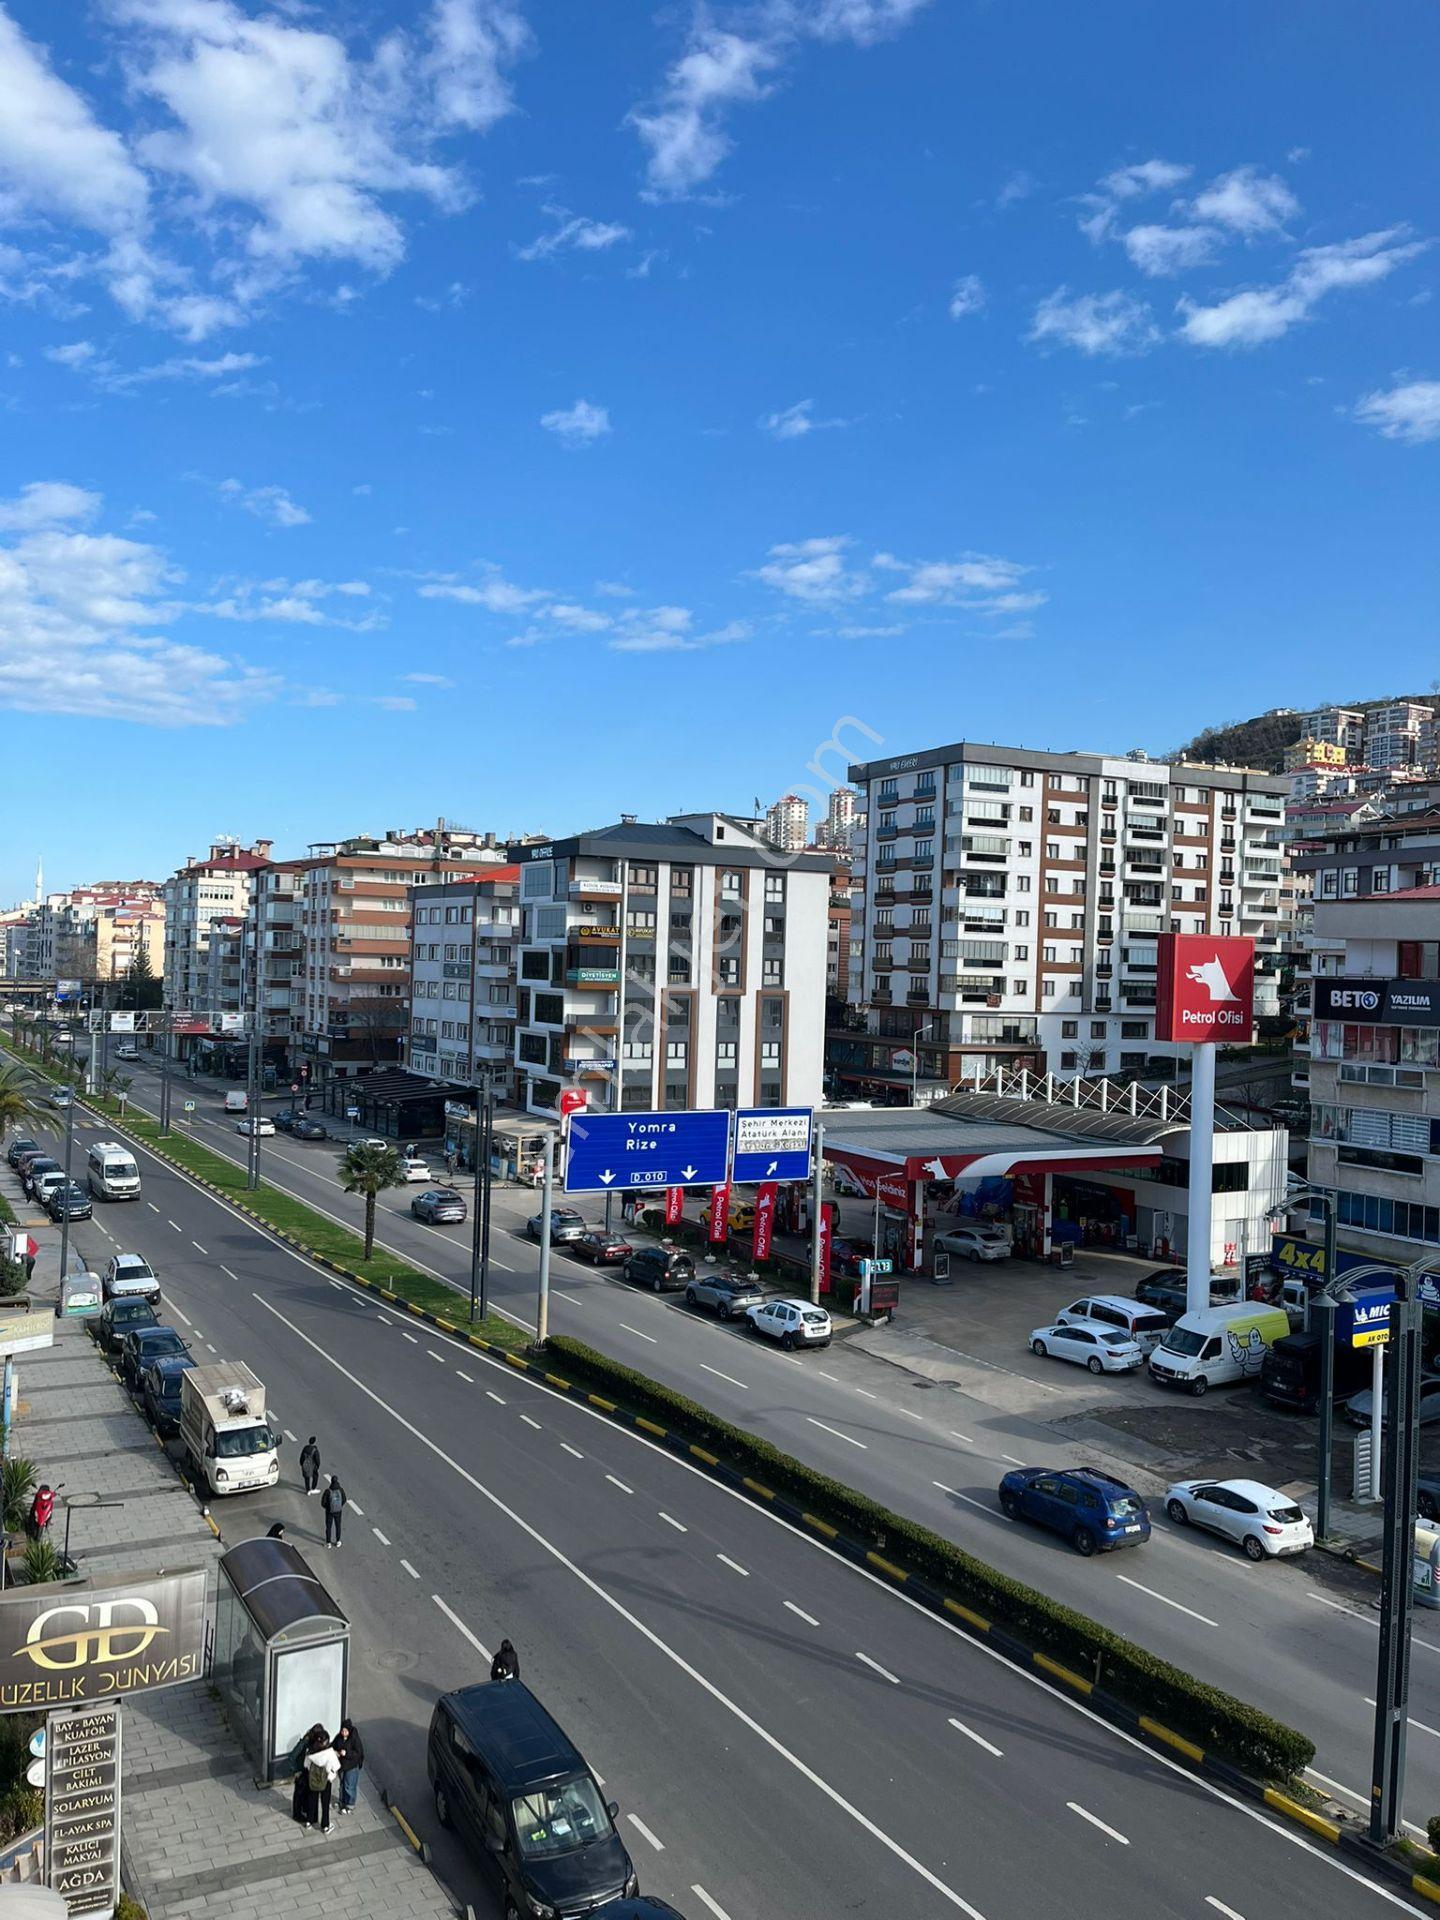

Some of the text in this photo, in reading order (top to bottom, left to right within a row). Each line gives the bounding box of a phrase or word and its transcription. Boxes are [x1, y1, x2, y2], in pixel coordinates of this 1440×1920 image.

[1330, 990, 1378, 1010] BETO
[1390, 994, 1430, 1006] YAZILIM
[1182, 1010, 1243, 1024] Petrol Ofisi
[628, 1122, 676, 1133] Yomra
[742, 1118, 806, 1128] Şehir Merkezi
[741, 1128, 806, 1138] Atatürk Alanı
[626, 1140, 657, 1150] Rize
[633, 1172, 663, 1181] D.010
[876, 1181, 906, 1198] eldiniz
[714, 1196, 724, 1239] Petrol Ofisi
[757, 1212, 768, 1256] Petrol Ofisi
[1279, 1242, 1326, 1273] 4x4
[1369, 1304, 1390, 1318] MIC
[26, 1598, 158, 1670] GD
[1, 1654, 196, 1704] ÜZELLİK DÜNYASI
[56, 1722, 74, 1732] BAY
[82, 1714, 114, 1727] BAYAN
[70, 1742, 100, 1755] LAZER
[66, 1777, 102, 1791] BAKIMI
[53, 1794, 113, 1814] SOLARYUM
[54, 1820, 112, 1838] EL-AYAK SPA
[66, 1841, 99, 1854] KALICI
[64, 1850, 101, 1865] MAKYAJ
[59, 1870, 104, 1891] AĞDA
